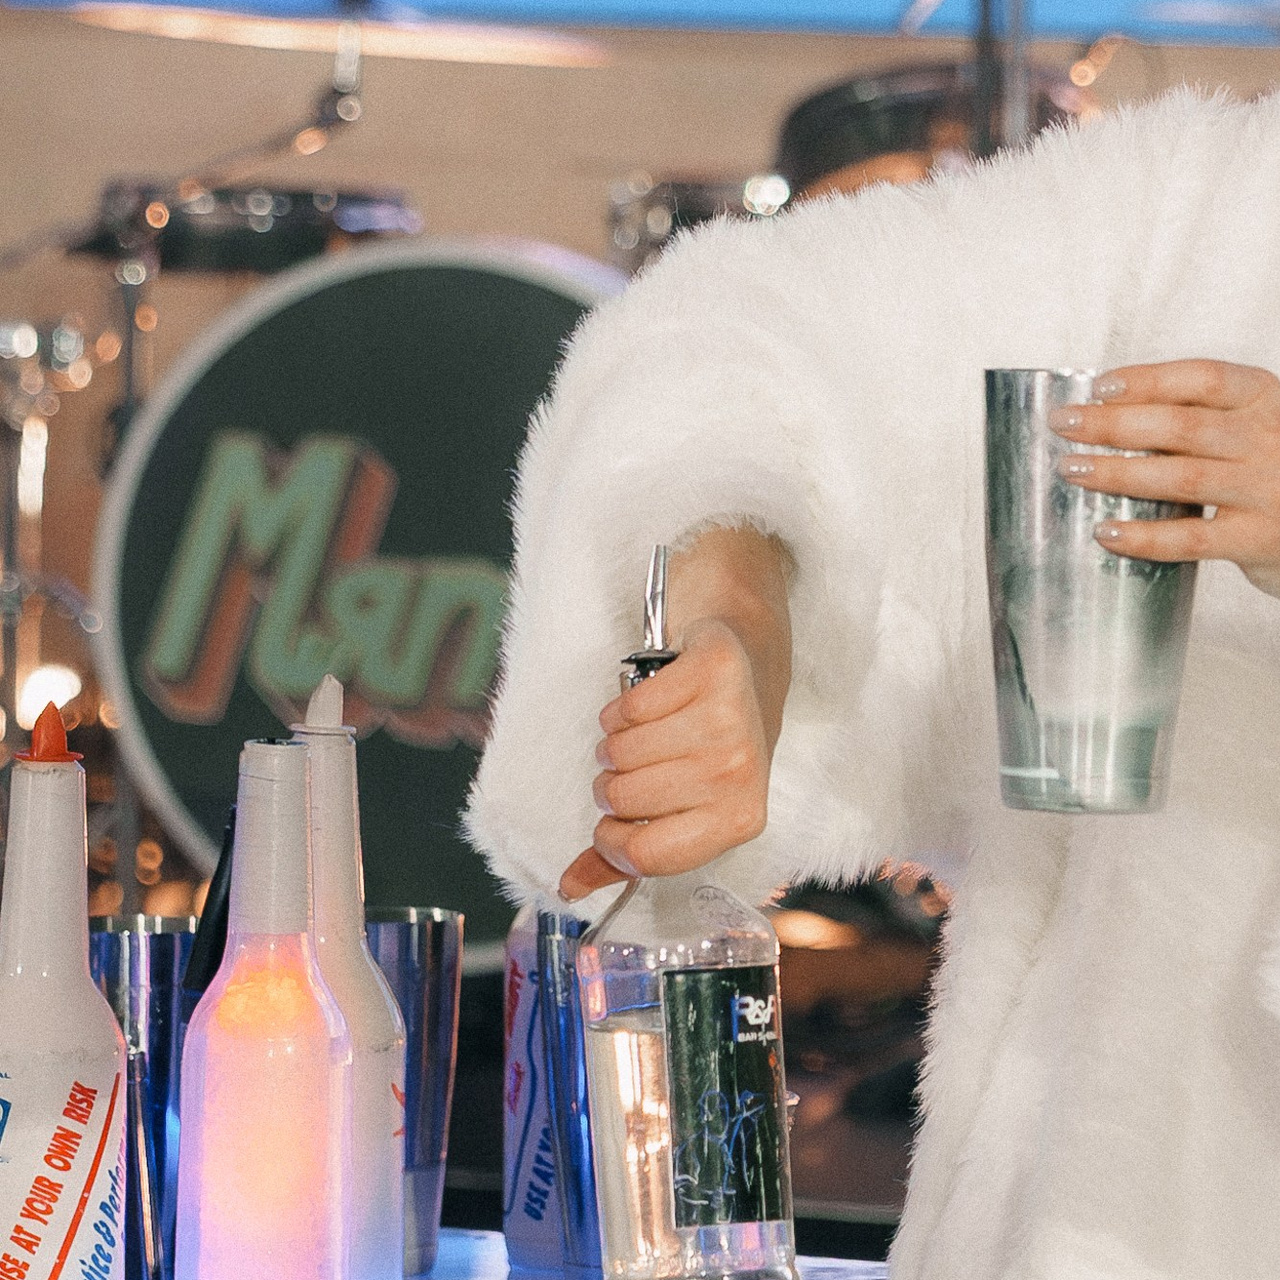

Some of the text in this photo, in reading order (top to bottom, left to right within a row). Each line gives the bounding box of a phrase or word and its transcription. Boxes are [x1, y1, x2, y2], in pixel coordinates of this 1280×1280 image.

[62, 1079, 99, 1126] RISK
[43, 1124, 84, 1173] OWN
[19, 1174, 64, 1227] YOUR
[9, 1223, 42, 1257] AT
